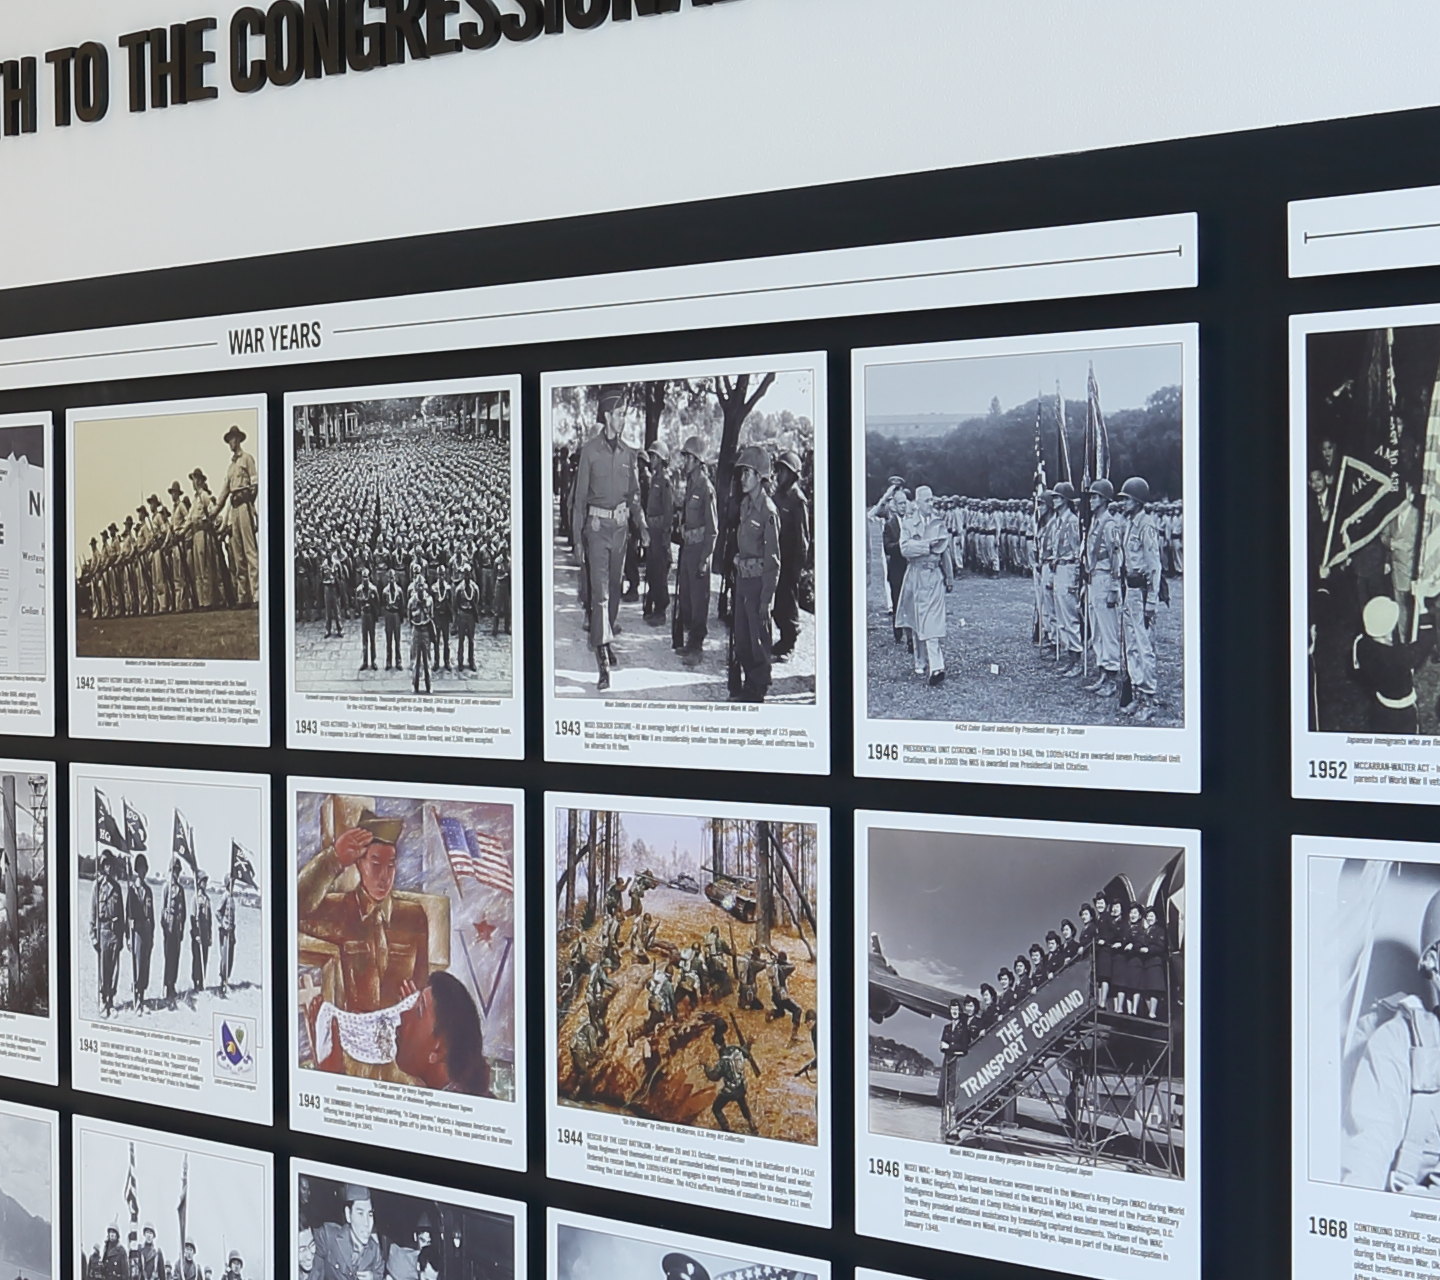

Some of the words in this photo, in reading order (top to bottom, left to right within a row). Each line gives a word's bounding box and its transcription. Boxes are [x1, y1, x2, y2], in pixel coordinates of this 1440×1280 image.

[45, 41, 109, 127] TO
[118, 17, 218, 113] THE
[229, 327, 265, 355] WAR
[270, 321, 321, 351] YEARS
[77, 677, 94, 689] 1942
[296, 720, 317, 734] 1943
[556, 721, 580, 735] 1943
[868, 744, 898, 760] 1946
[1309, 761, 1347, 779] 1952
[80, 1038, 98, 1053] 1943
[299, 1094, 320, 1109] 1943
[558, 1129, 583, 1145] 1944
[870, 1158, 899, 1177] 1946
[1310, 1217, 1347, 1238] 1968
